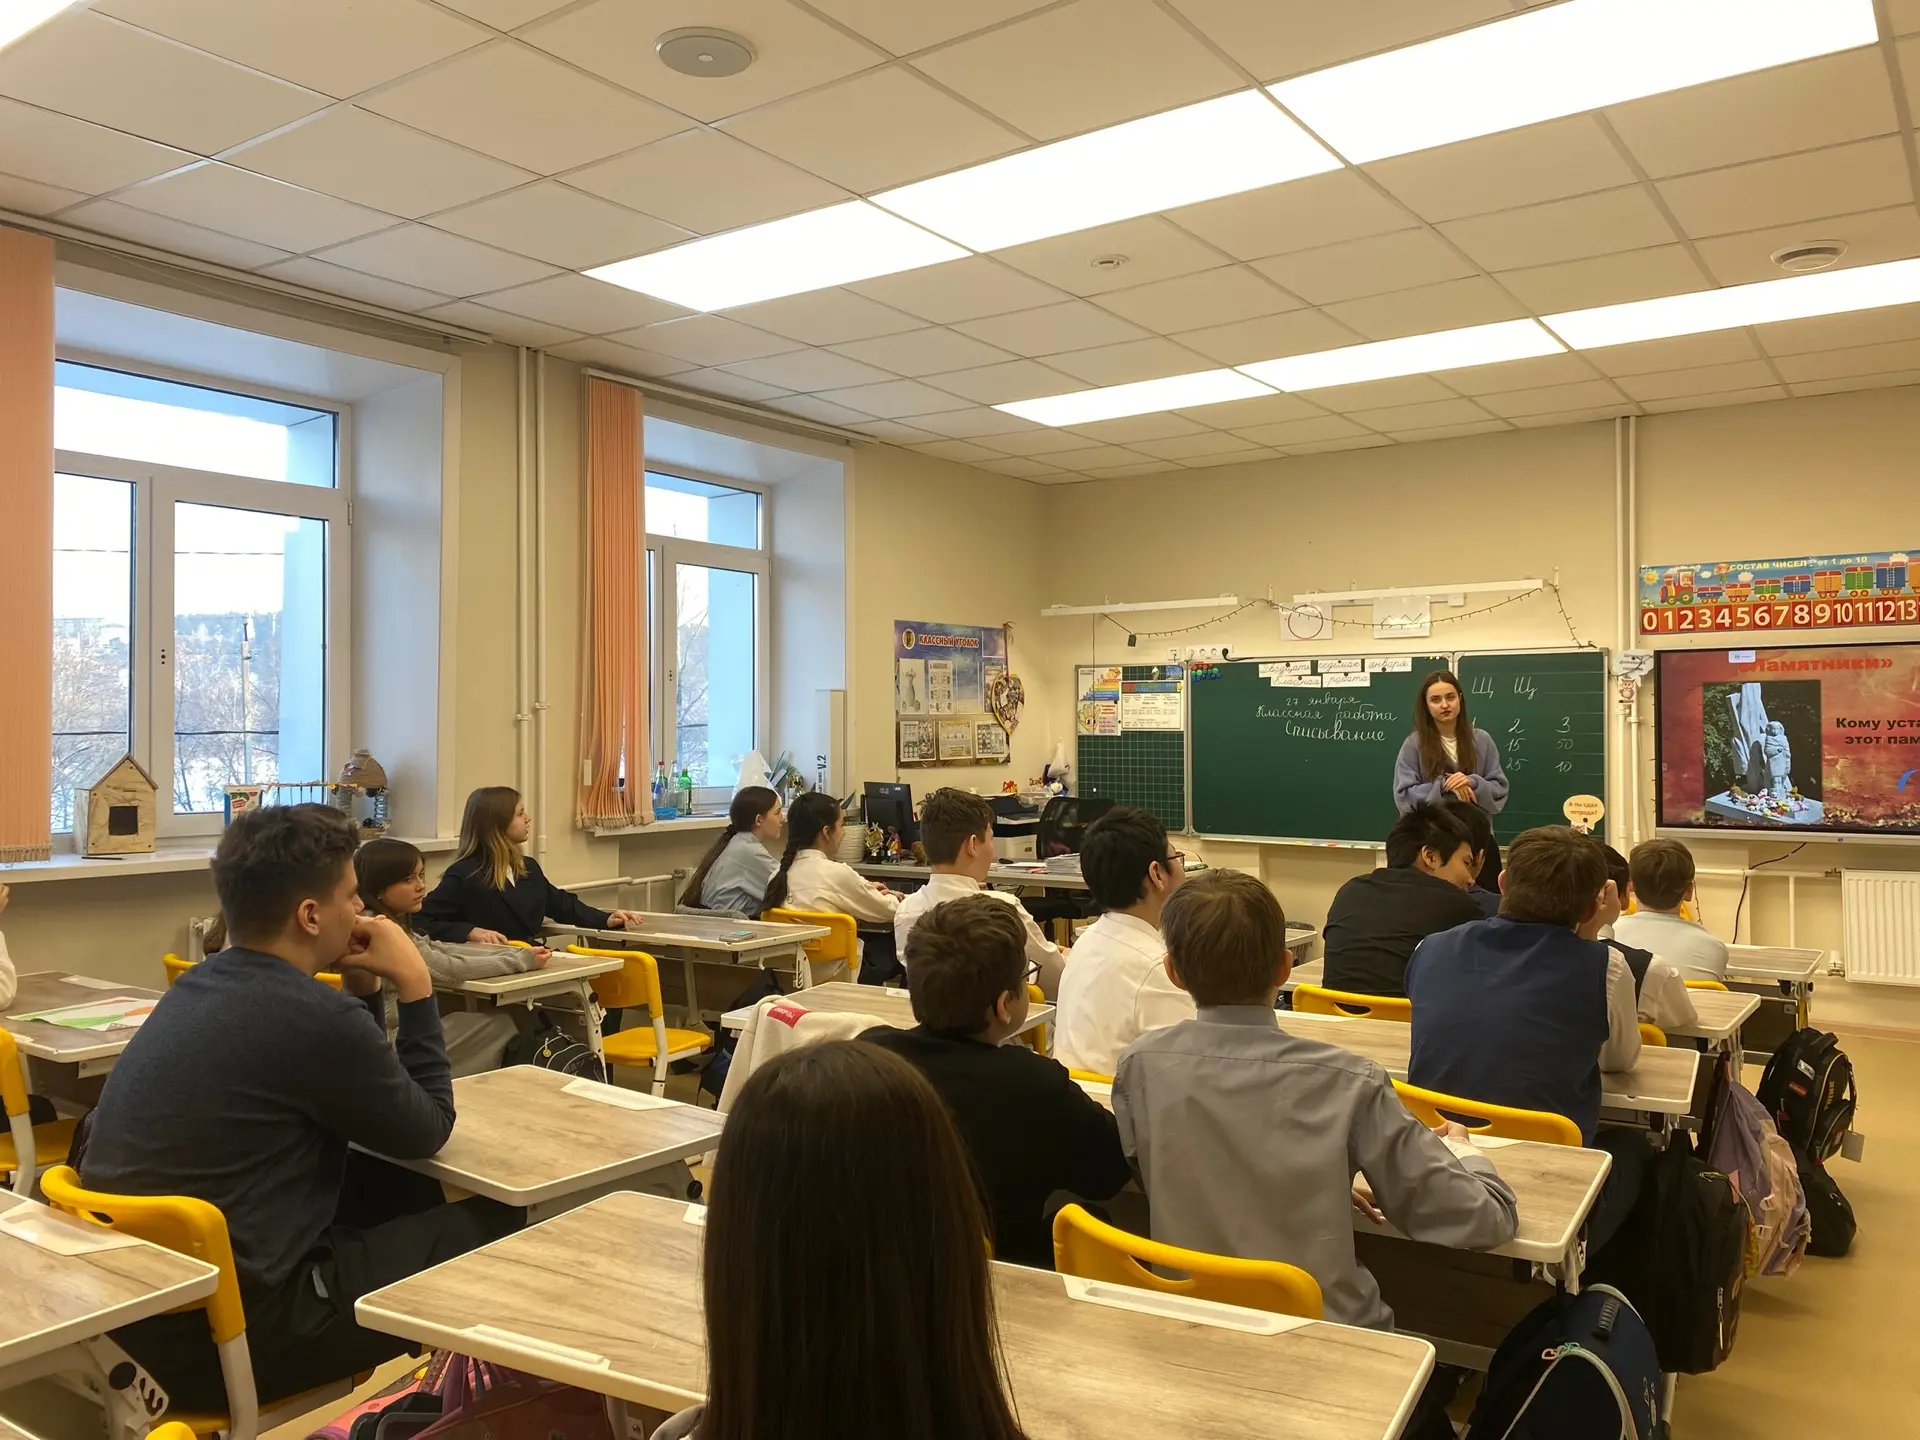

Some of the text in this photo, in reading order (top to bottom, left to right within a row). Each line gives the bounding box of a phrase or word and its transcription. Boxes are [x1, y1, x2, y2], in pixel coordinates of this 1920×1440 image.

[1729, 561, 1770, 571] СОСТАВ
[1772, 559, 1808, 568] ЧИСЕЛ
[1643, 599, 1917, 630] 0 1 2 3 4 5 6 7 8 9 10 11 12 13
[918, 634, 979, 648] КЛАССНЫЙ УГОЛОК
[1308, 692, 1361, 709] января
[1256, 704, 1398, 723] Классная работа
[1285, 720, 1386, 741] Списывание
[1508, 718, 1526, 734] 2
[1555, 716, 1571, 733] 3
[1836, 718, 1881, 730] Кому
[1504, 738, 1526, 752] 15
[1845, 736, 1882, 744] этот
[1506, 758, 1572, 772] 25 10
